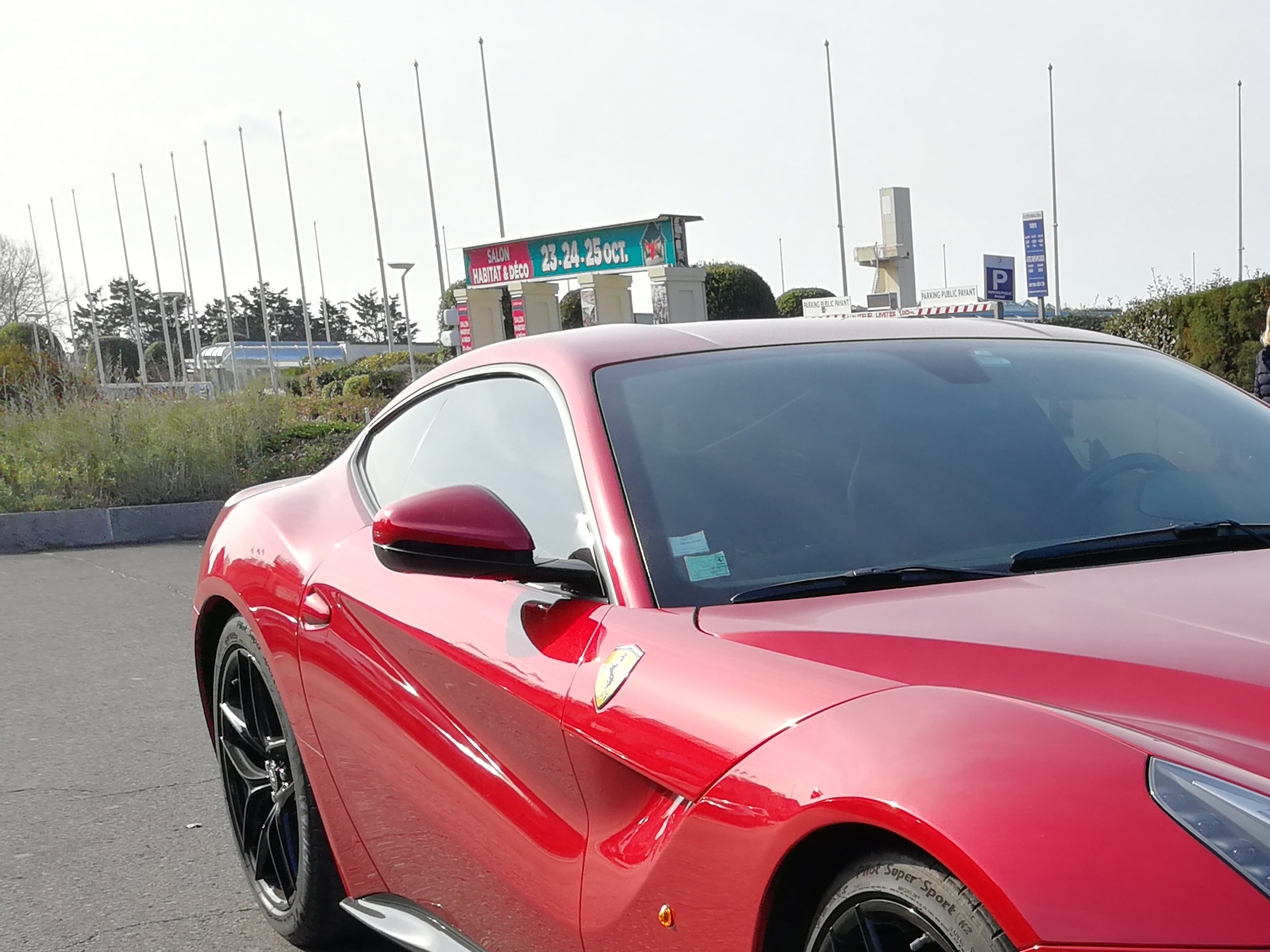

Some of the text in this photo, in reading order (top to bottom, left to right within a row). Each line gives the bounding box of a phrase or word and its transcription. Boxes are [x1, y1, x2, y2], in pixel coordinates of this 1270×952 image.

[486, 245, 510, 264] SALON
[472, 264, 502, 284] HABITAT
[509, 260, 530, 280] DÉCO
[992, 269, 1008, 290] P
[921, 289, 940, 300] PARKING
[941, 288, 957, 298] PUBLIC
[958, 287, 976, 297] PAYANT
[884, 863, 918, 884] Super
[920, 879, 957, 916] Sport
[958, 919, 973, 935] K2
